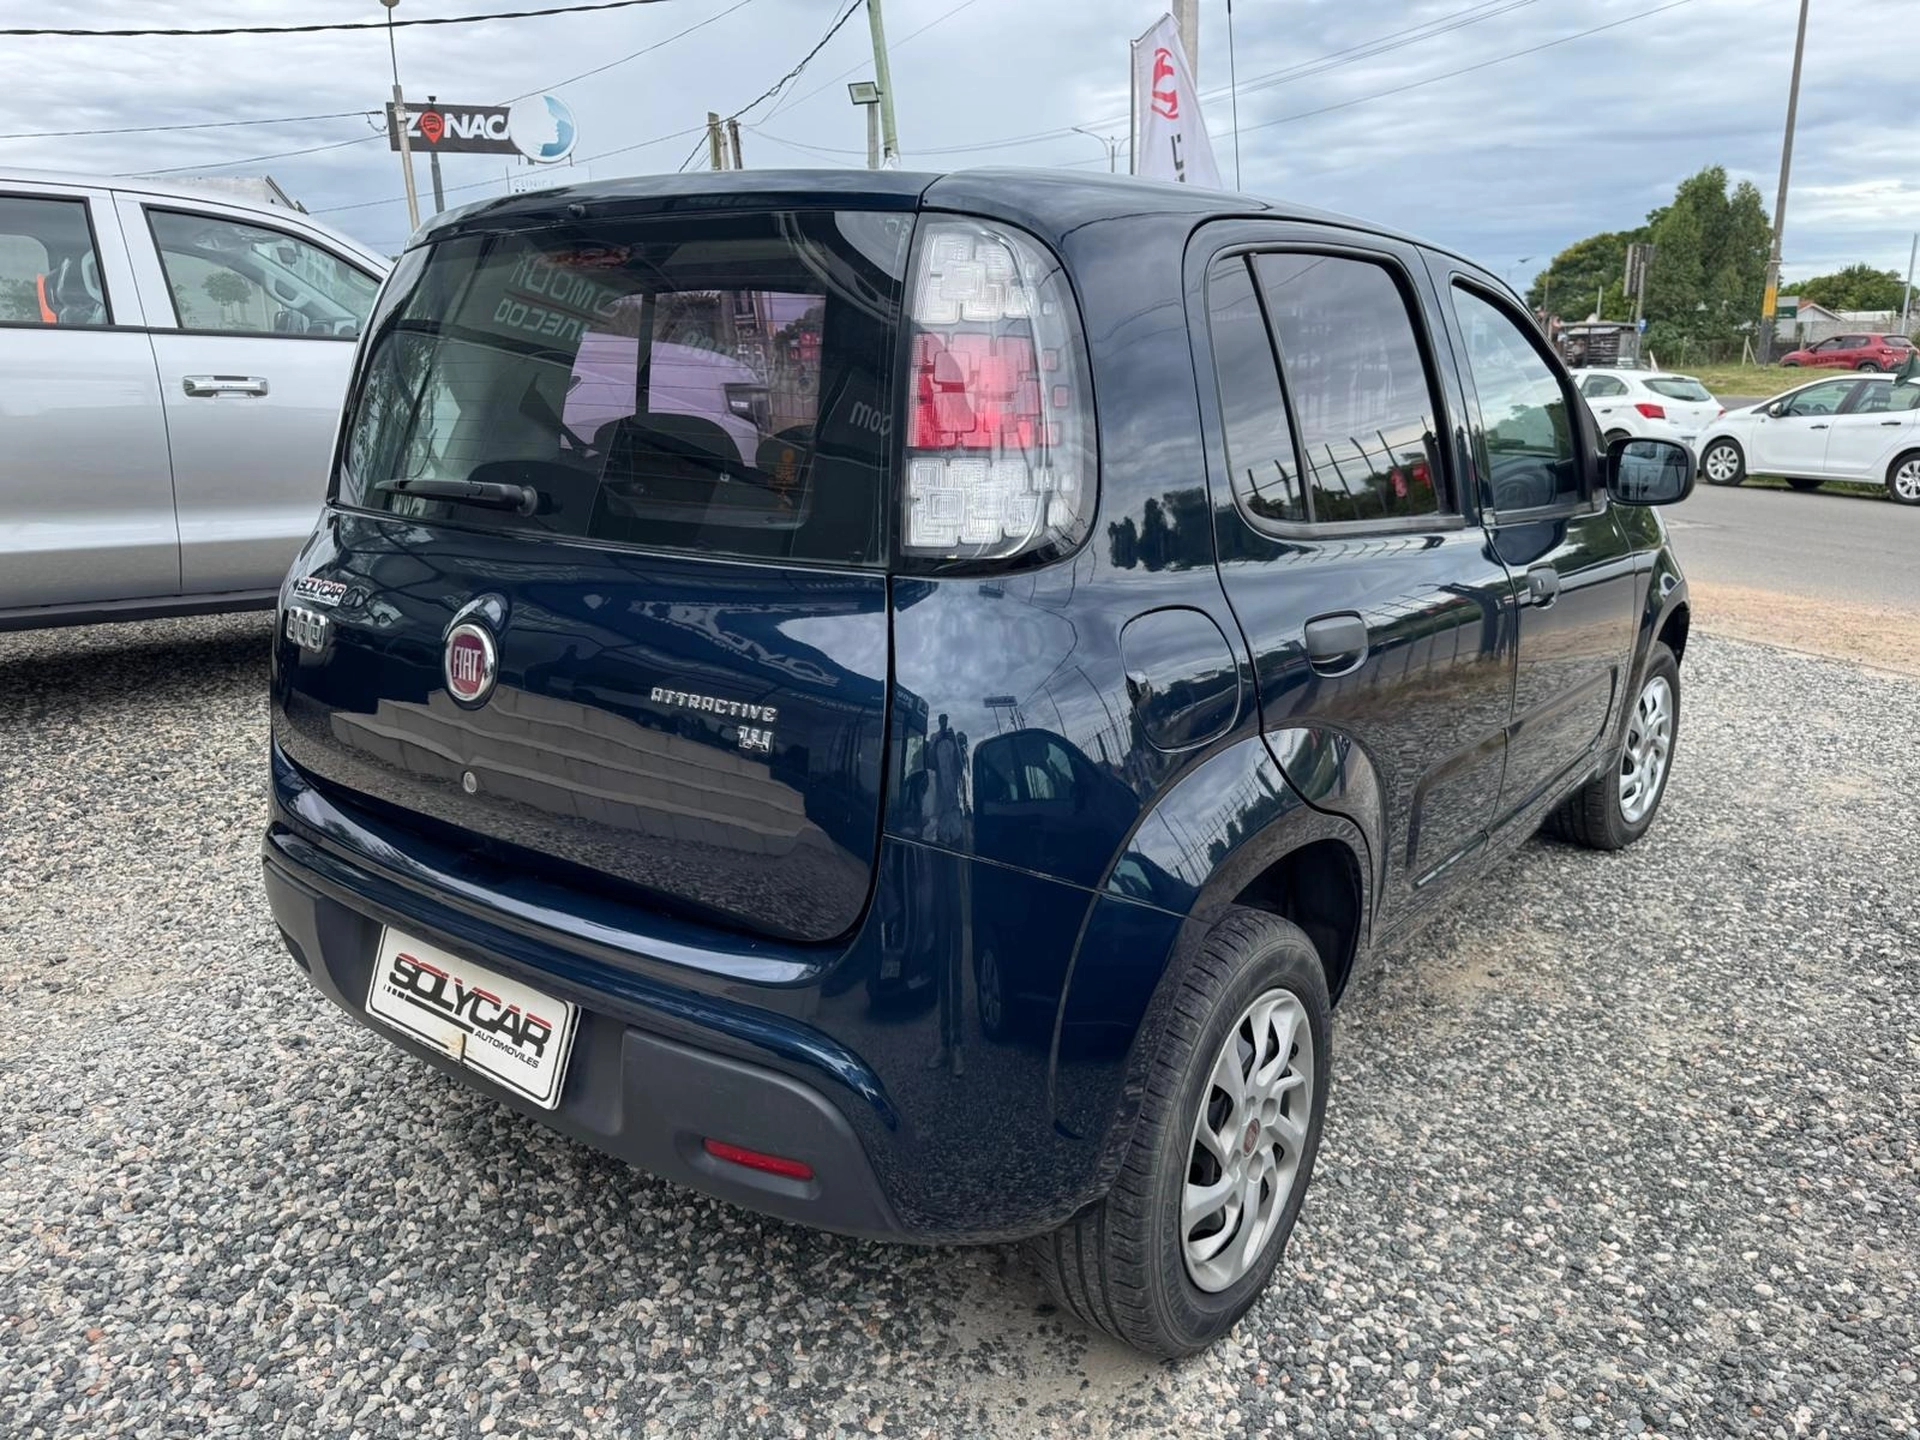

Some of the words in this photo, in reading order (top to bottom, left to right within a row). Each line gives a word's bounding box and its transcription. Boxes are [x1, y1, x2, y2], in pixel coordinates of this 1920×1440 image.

[405, 110, 510, 142] ZONAC
[298, 577, 346, 598] SOLYCAR
[453, 646, 481, 681] FIAT
[651, 687, 777, 722] ATTRACTIVE
[389, 953, 552, 1057] SOLYCAR
[475, 1029, 540, 1069] AUTOMOVILES
